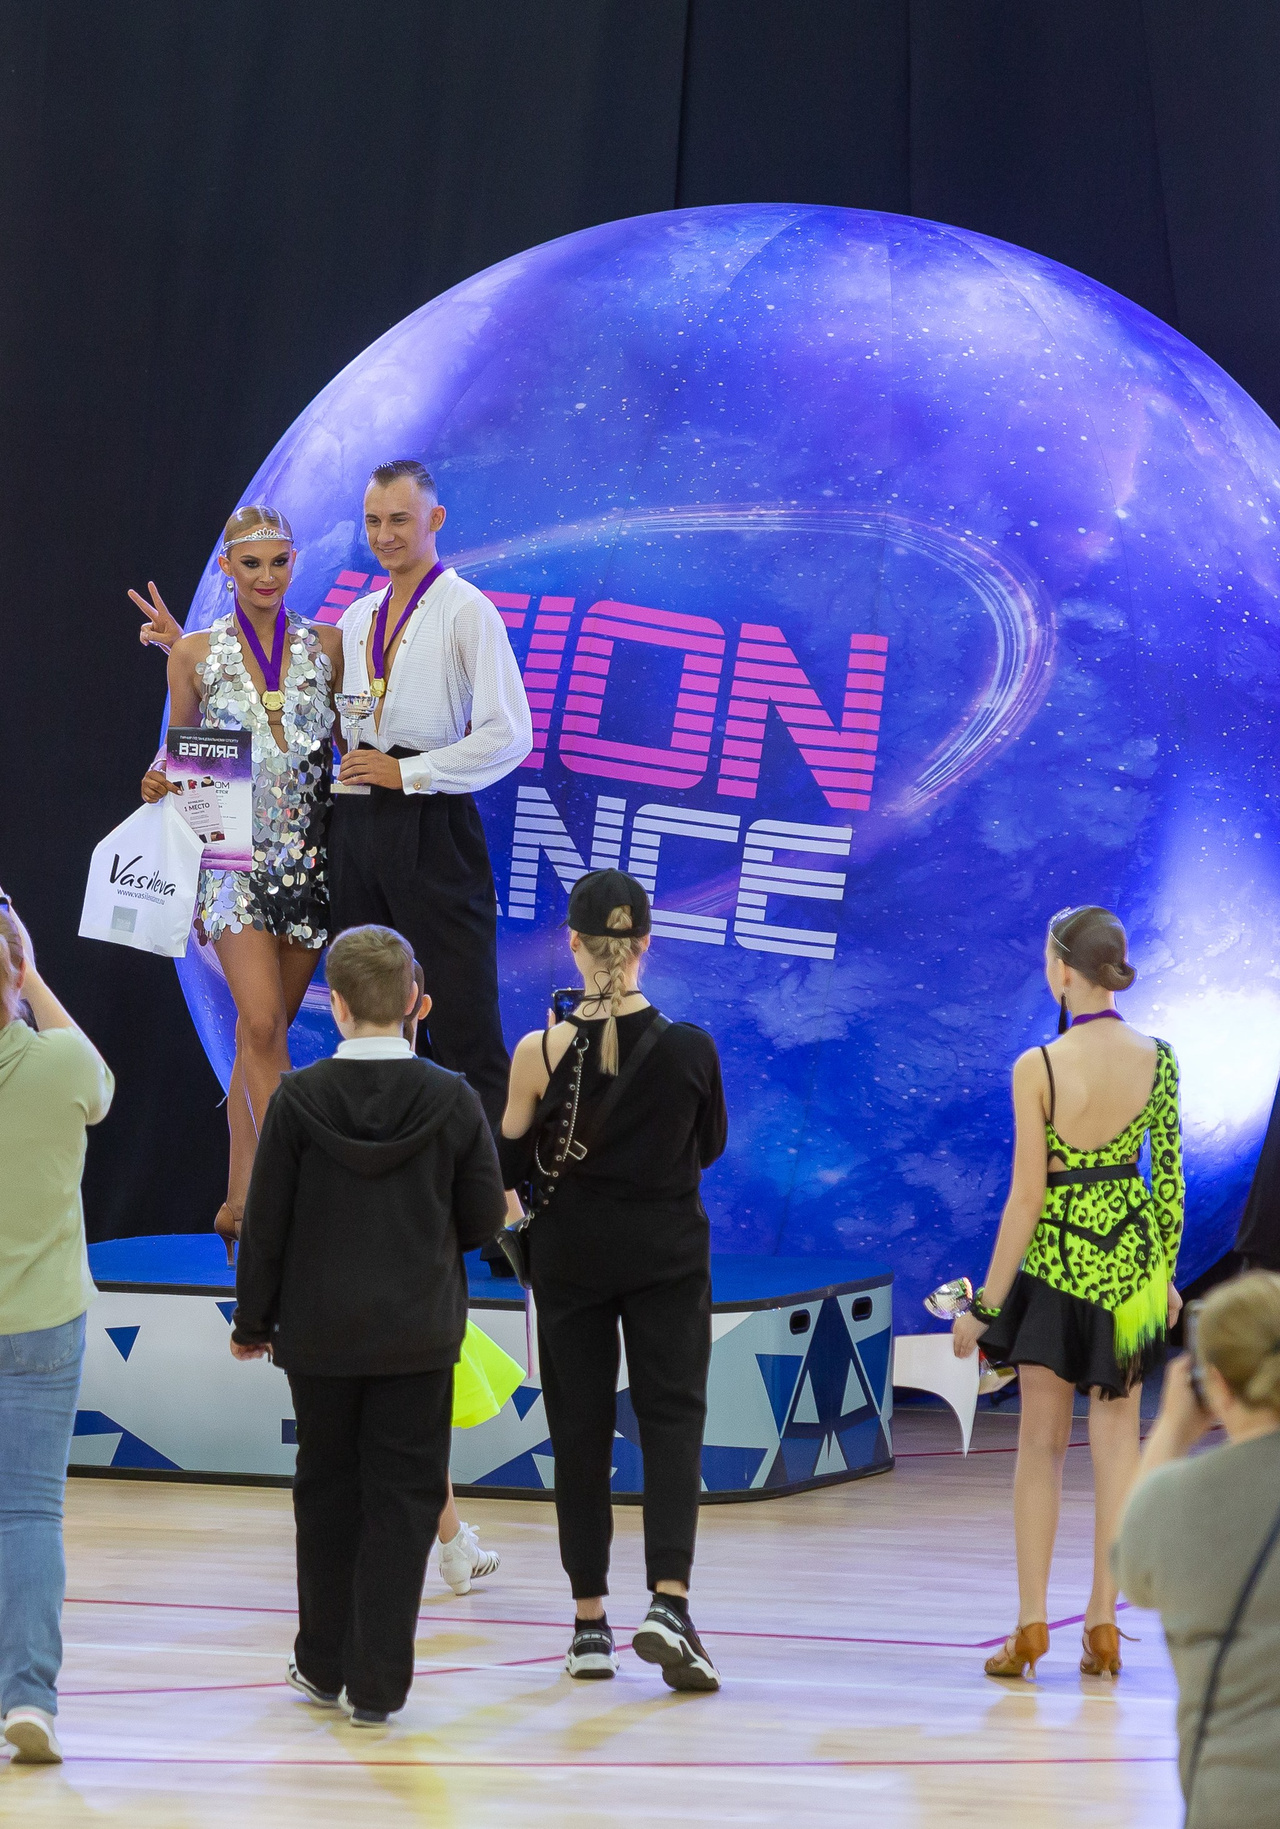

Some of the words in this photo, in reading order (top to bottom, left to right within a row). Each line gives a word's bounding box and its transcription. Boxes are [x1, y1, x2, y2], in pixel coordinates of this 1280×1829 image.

[314, 569, 888, 811] ION
[179, 742, 239, 759] ВЗГЛЯД
[188, 802, 210, 811] МЕСТО
[109, 853, 176, 897] Vasileva
[496, 786, 853, 959] NCE
